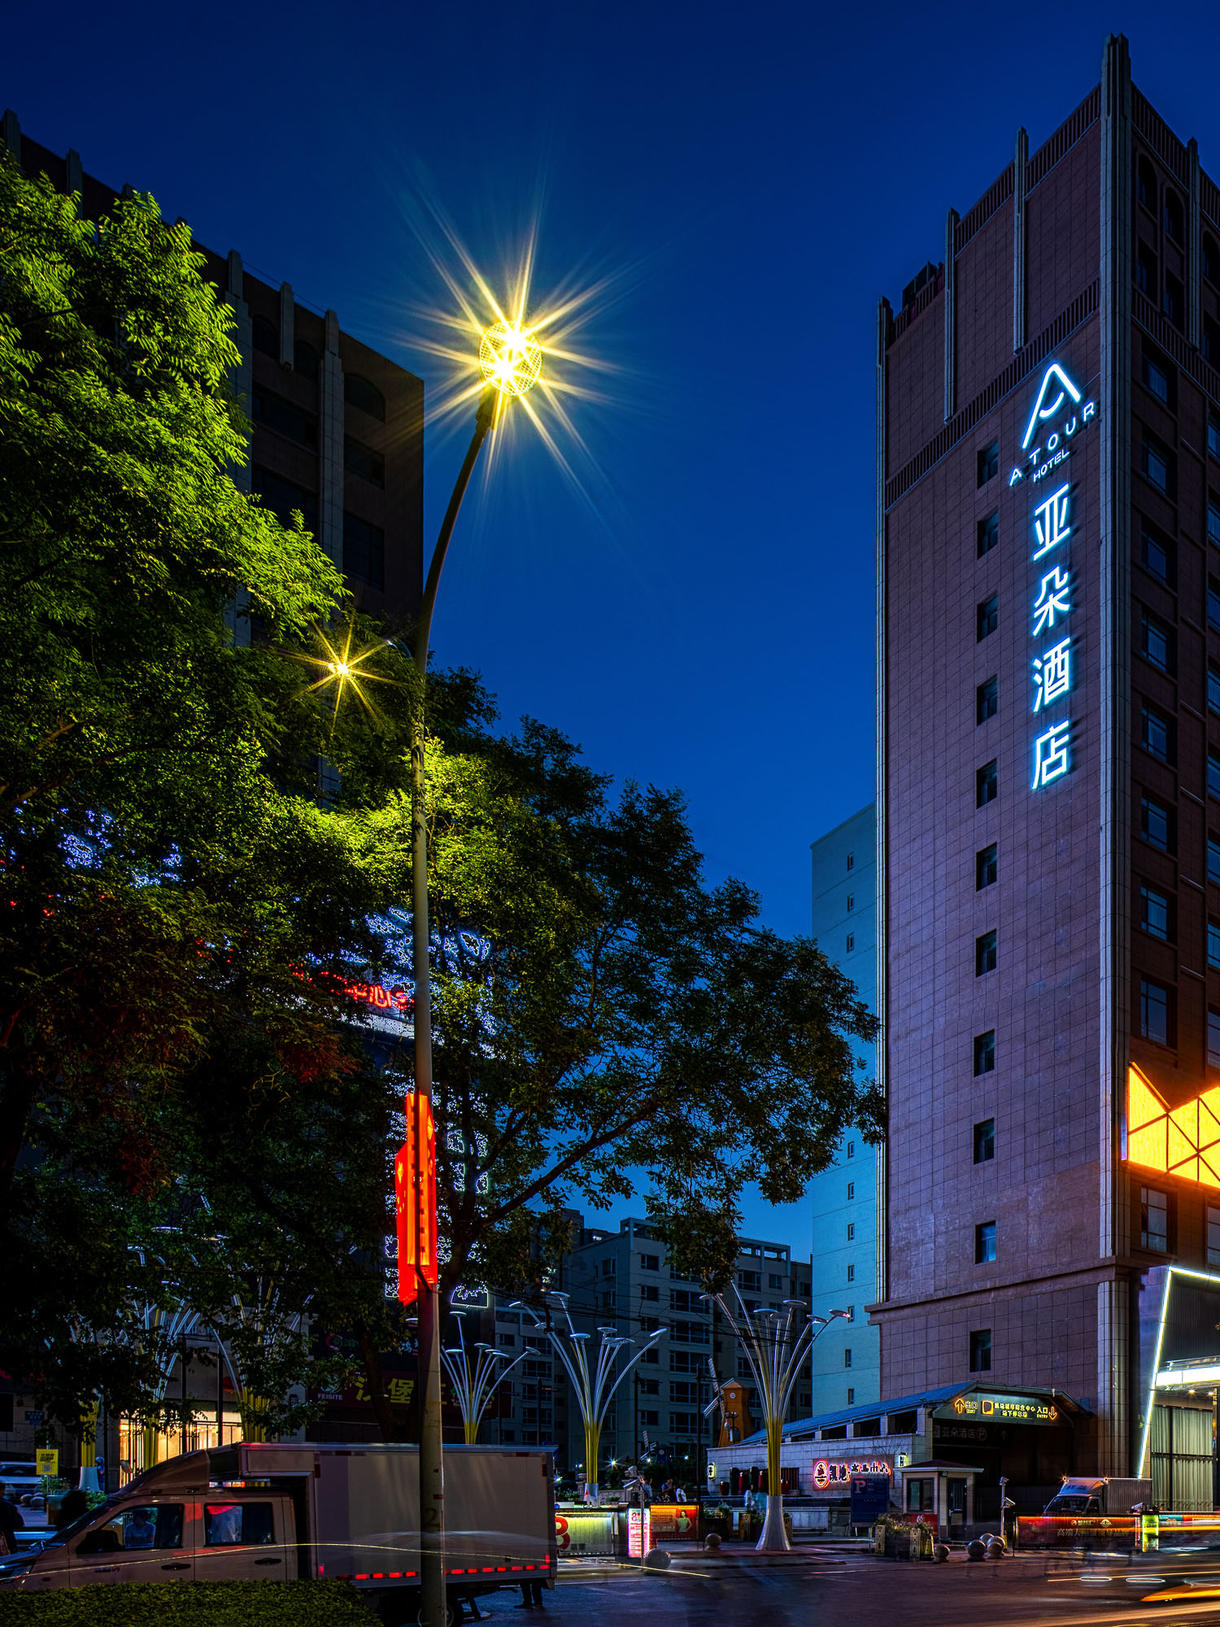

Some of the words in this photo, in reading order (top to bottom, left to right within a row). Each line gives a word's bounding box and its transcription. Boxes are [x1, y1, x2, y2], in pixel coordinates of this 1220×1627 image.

[1009, 401, 1095, 486] ATOUR
[1033, 449, 1070, 483] HOTEL
[1032, 483, 1071, 790] 亚朵酒店
[1036, 1406, 1049, 1414] 入口
